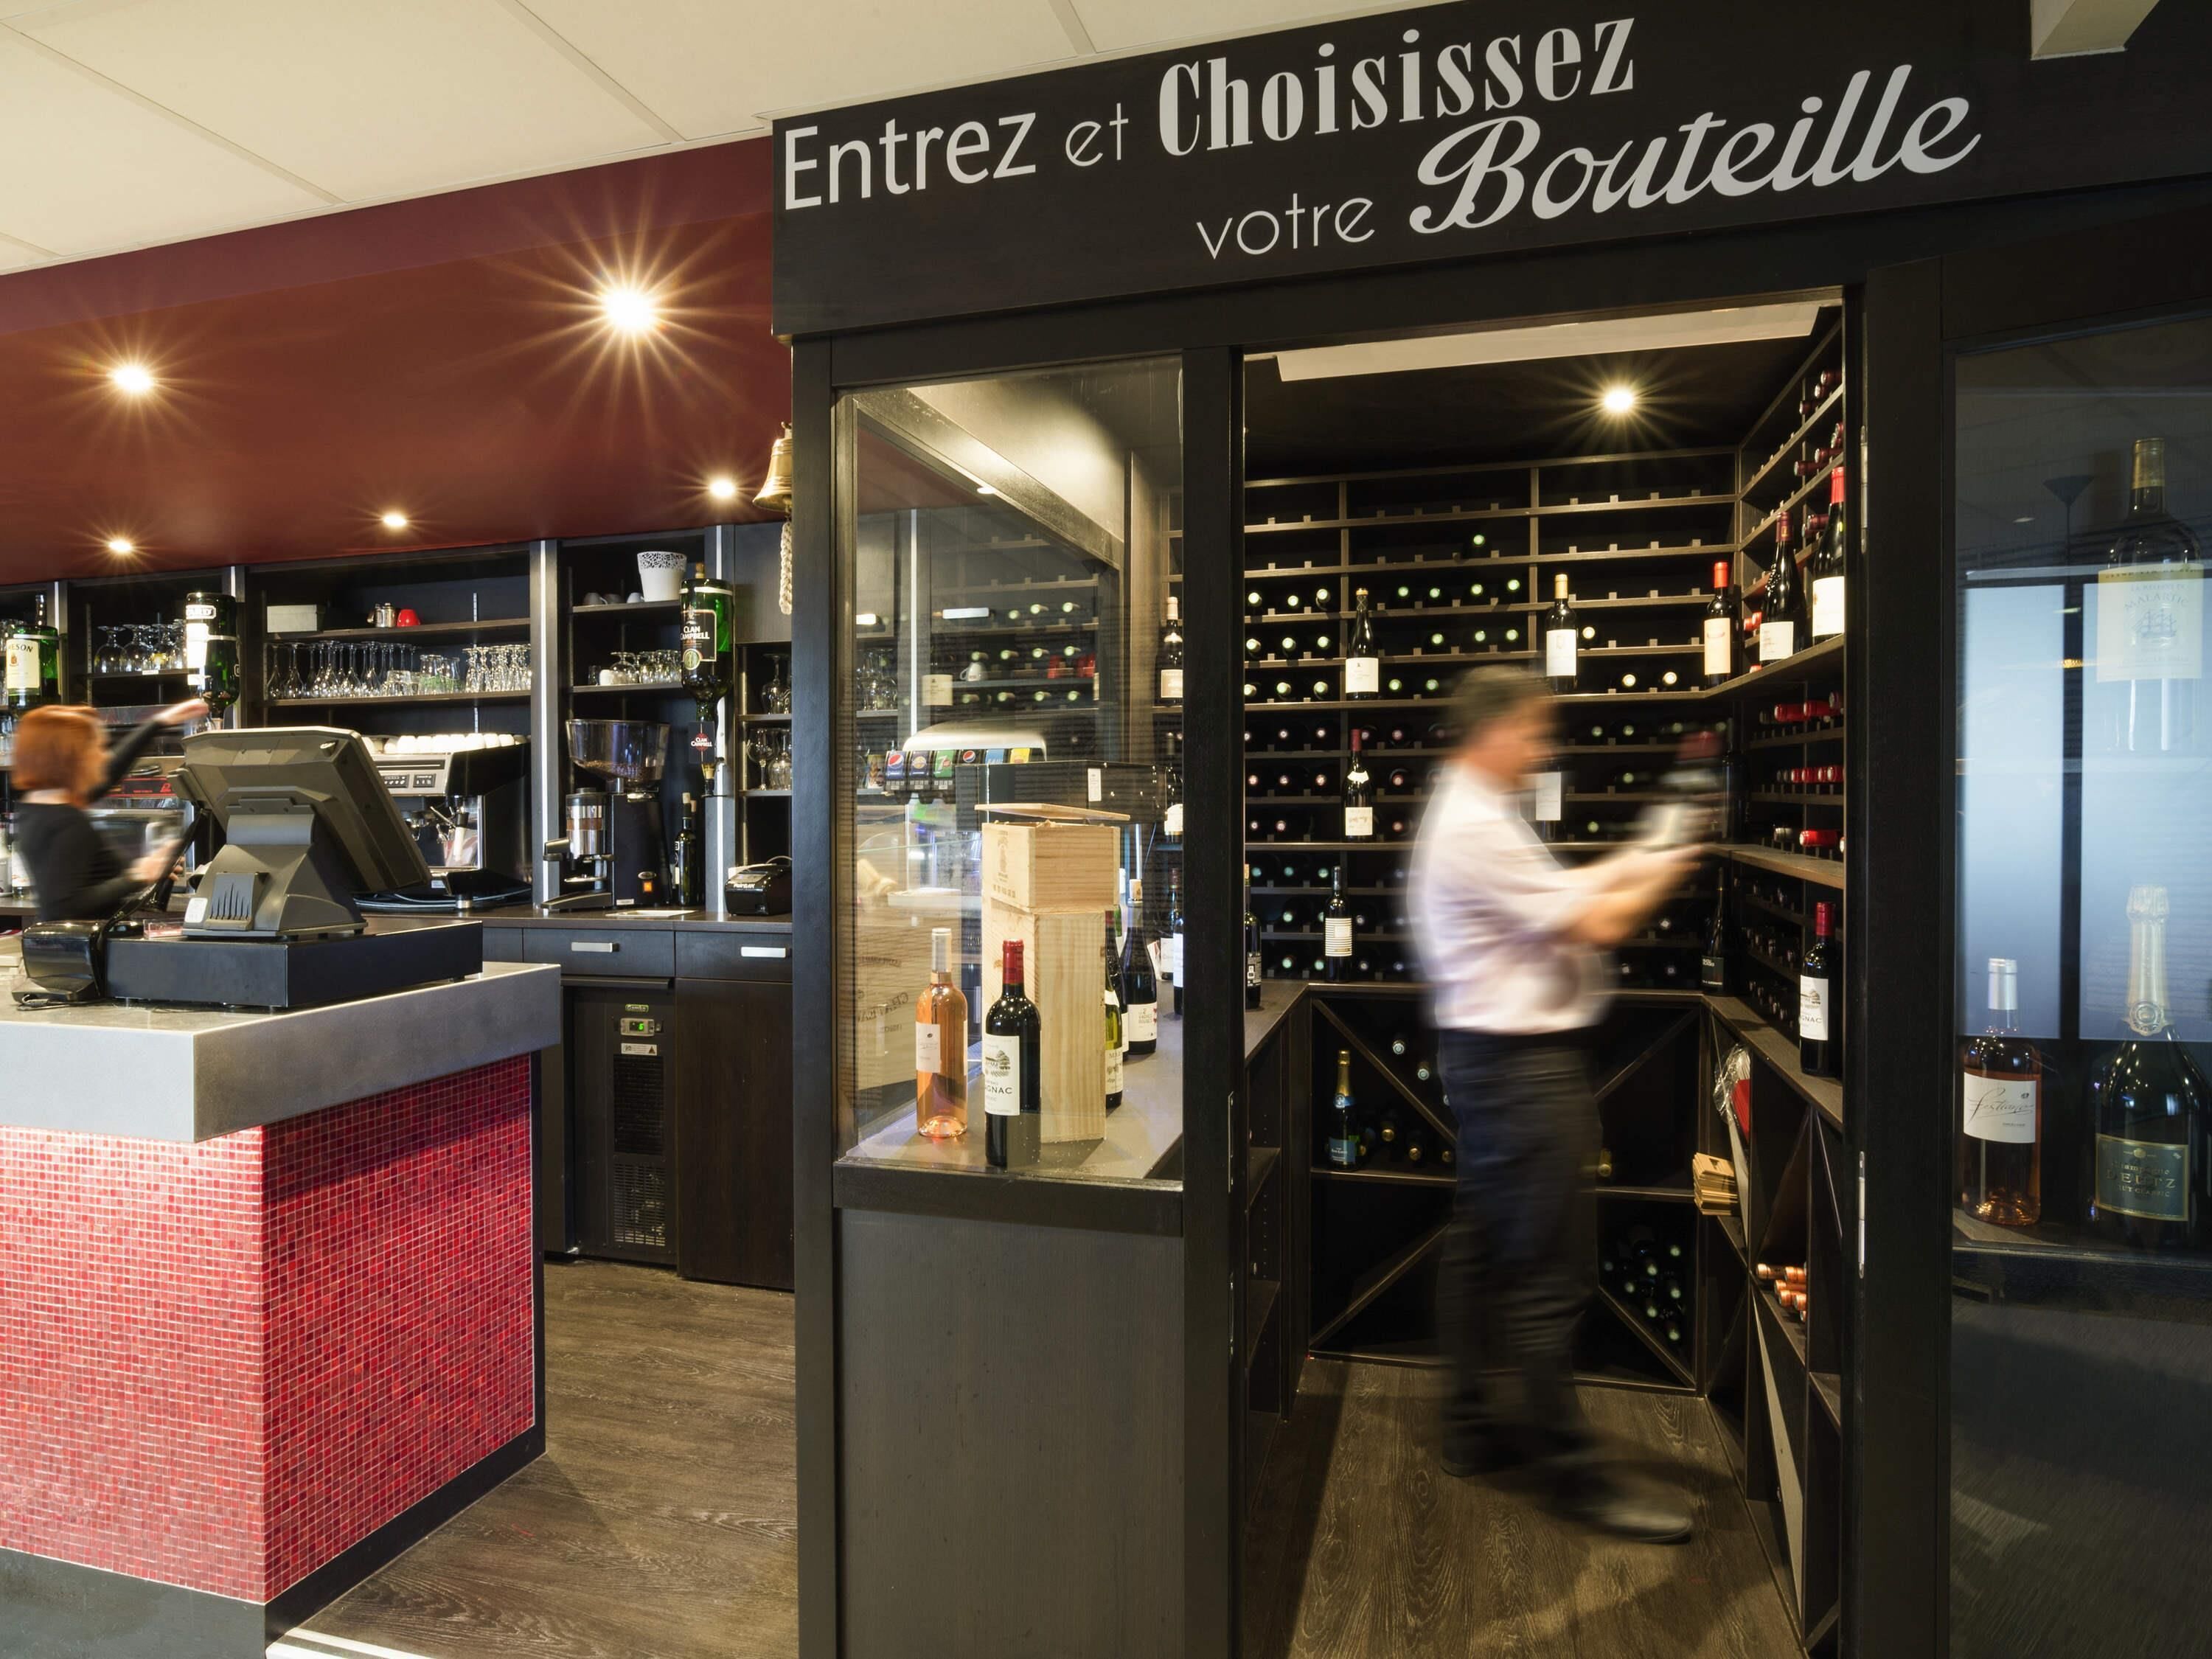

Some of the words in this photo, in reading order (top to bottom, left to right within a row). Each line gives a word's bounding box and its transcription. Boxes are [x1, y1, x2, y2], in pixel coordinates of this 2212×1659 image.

[785, 111, 1037, 210] Entrez
[1065, 102, 1129, 167] et
[1159, 18, 1635, 156] Choisissez
[1196, 192, 1376, 260] votre
[1409, 64, 1981, 234] Bouteille
[1801, 1015, 1822, 1023] GNAC
[985, 1085, 1012, 1094] GNAC
